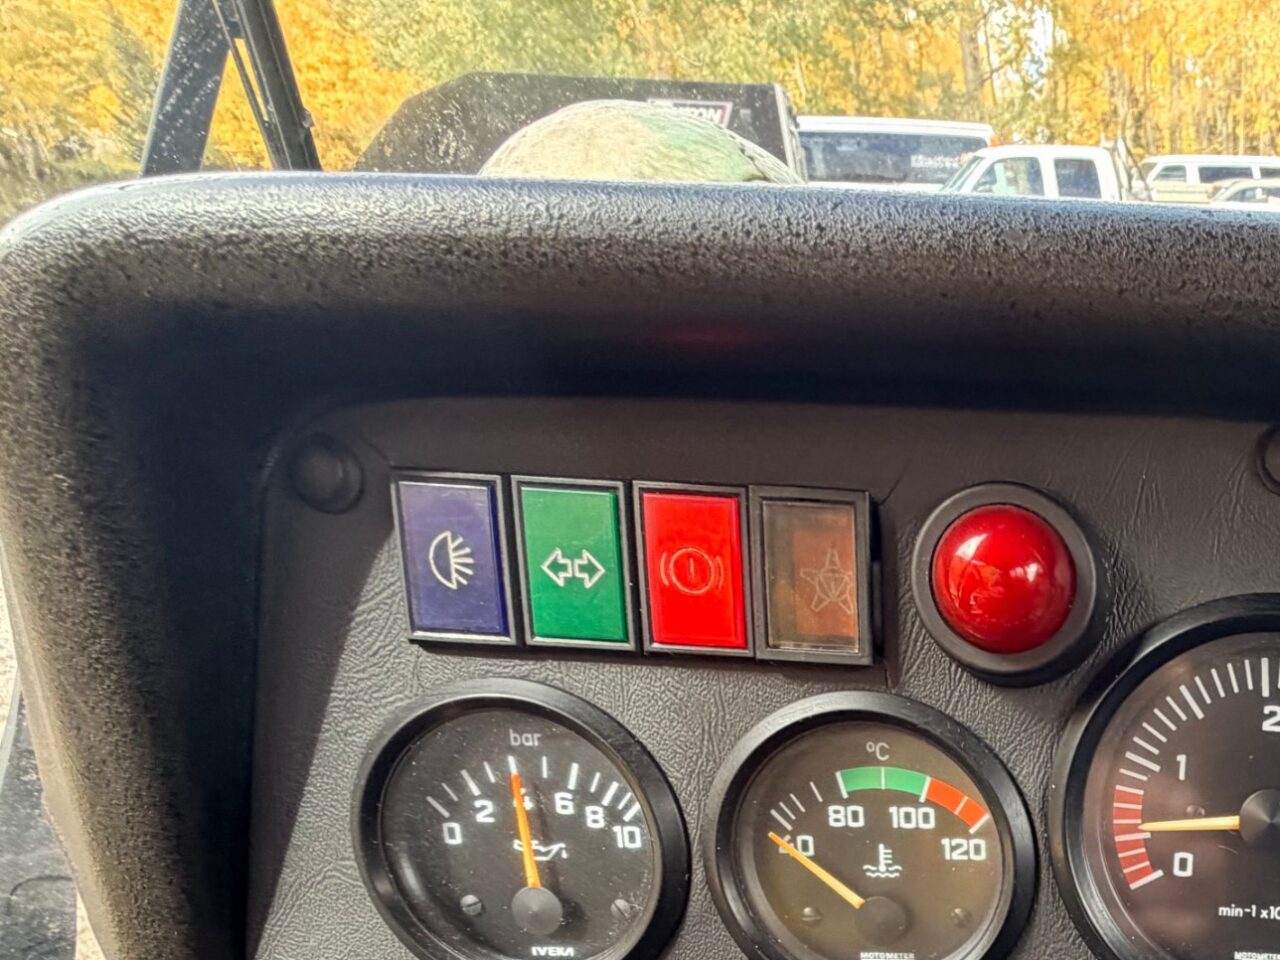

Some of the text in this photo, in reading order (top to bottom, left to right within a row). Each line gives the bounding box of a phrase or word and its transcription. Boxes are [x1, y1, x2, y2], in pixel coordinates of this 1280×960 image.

[509, 729, 542, 747] bar
[1176, 754, 1187, 780] 1
[474, 800, 496, 823] 2
[553, 792, 576, 815] 6
[585, 806, 605, 829] 8
[828, 805, 865, 828] 80
[889, 806, 935, 829] 100
[442, 822, 463, 845] 0
[612, 825, 642, 849] 10
[941, 837, 987, 860] 120
[1173, 852, 1194, 877] 0
